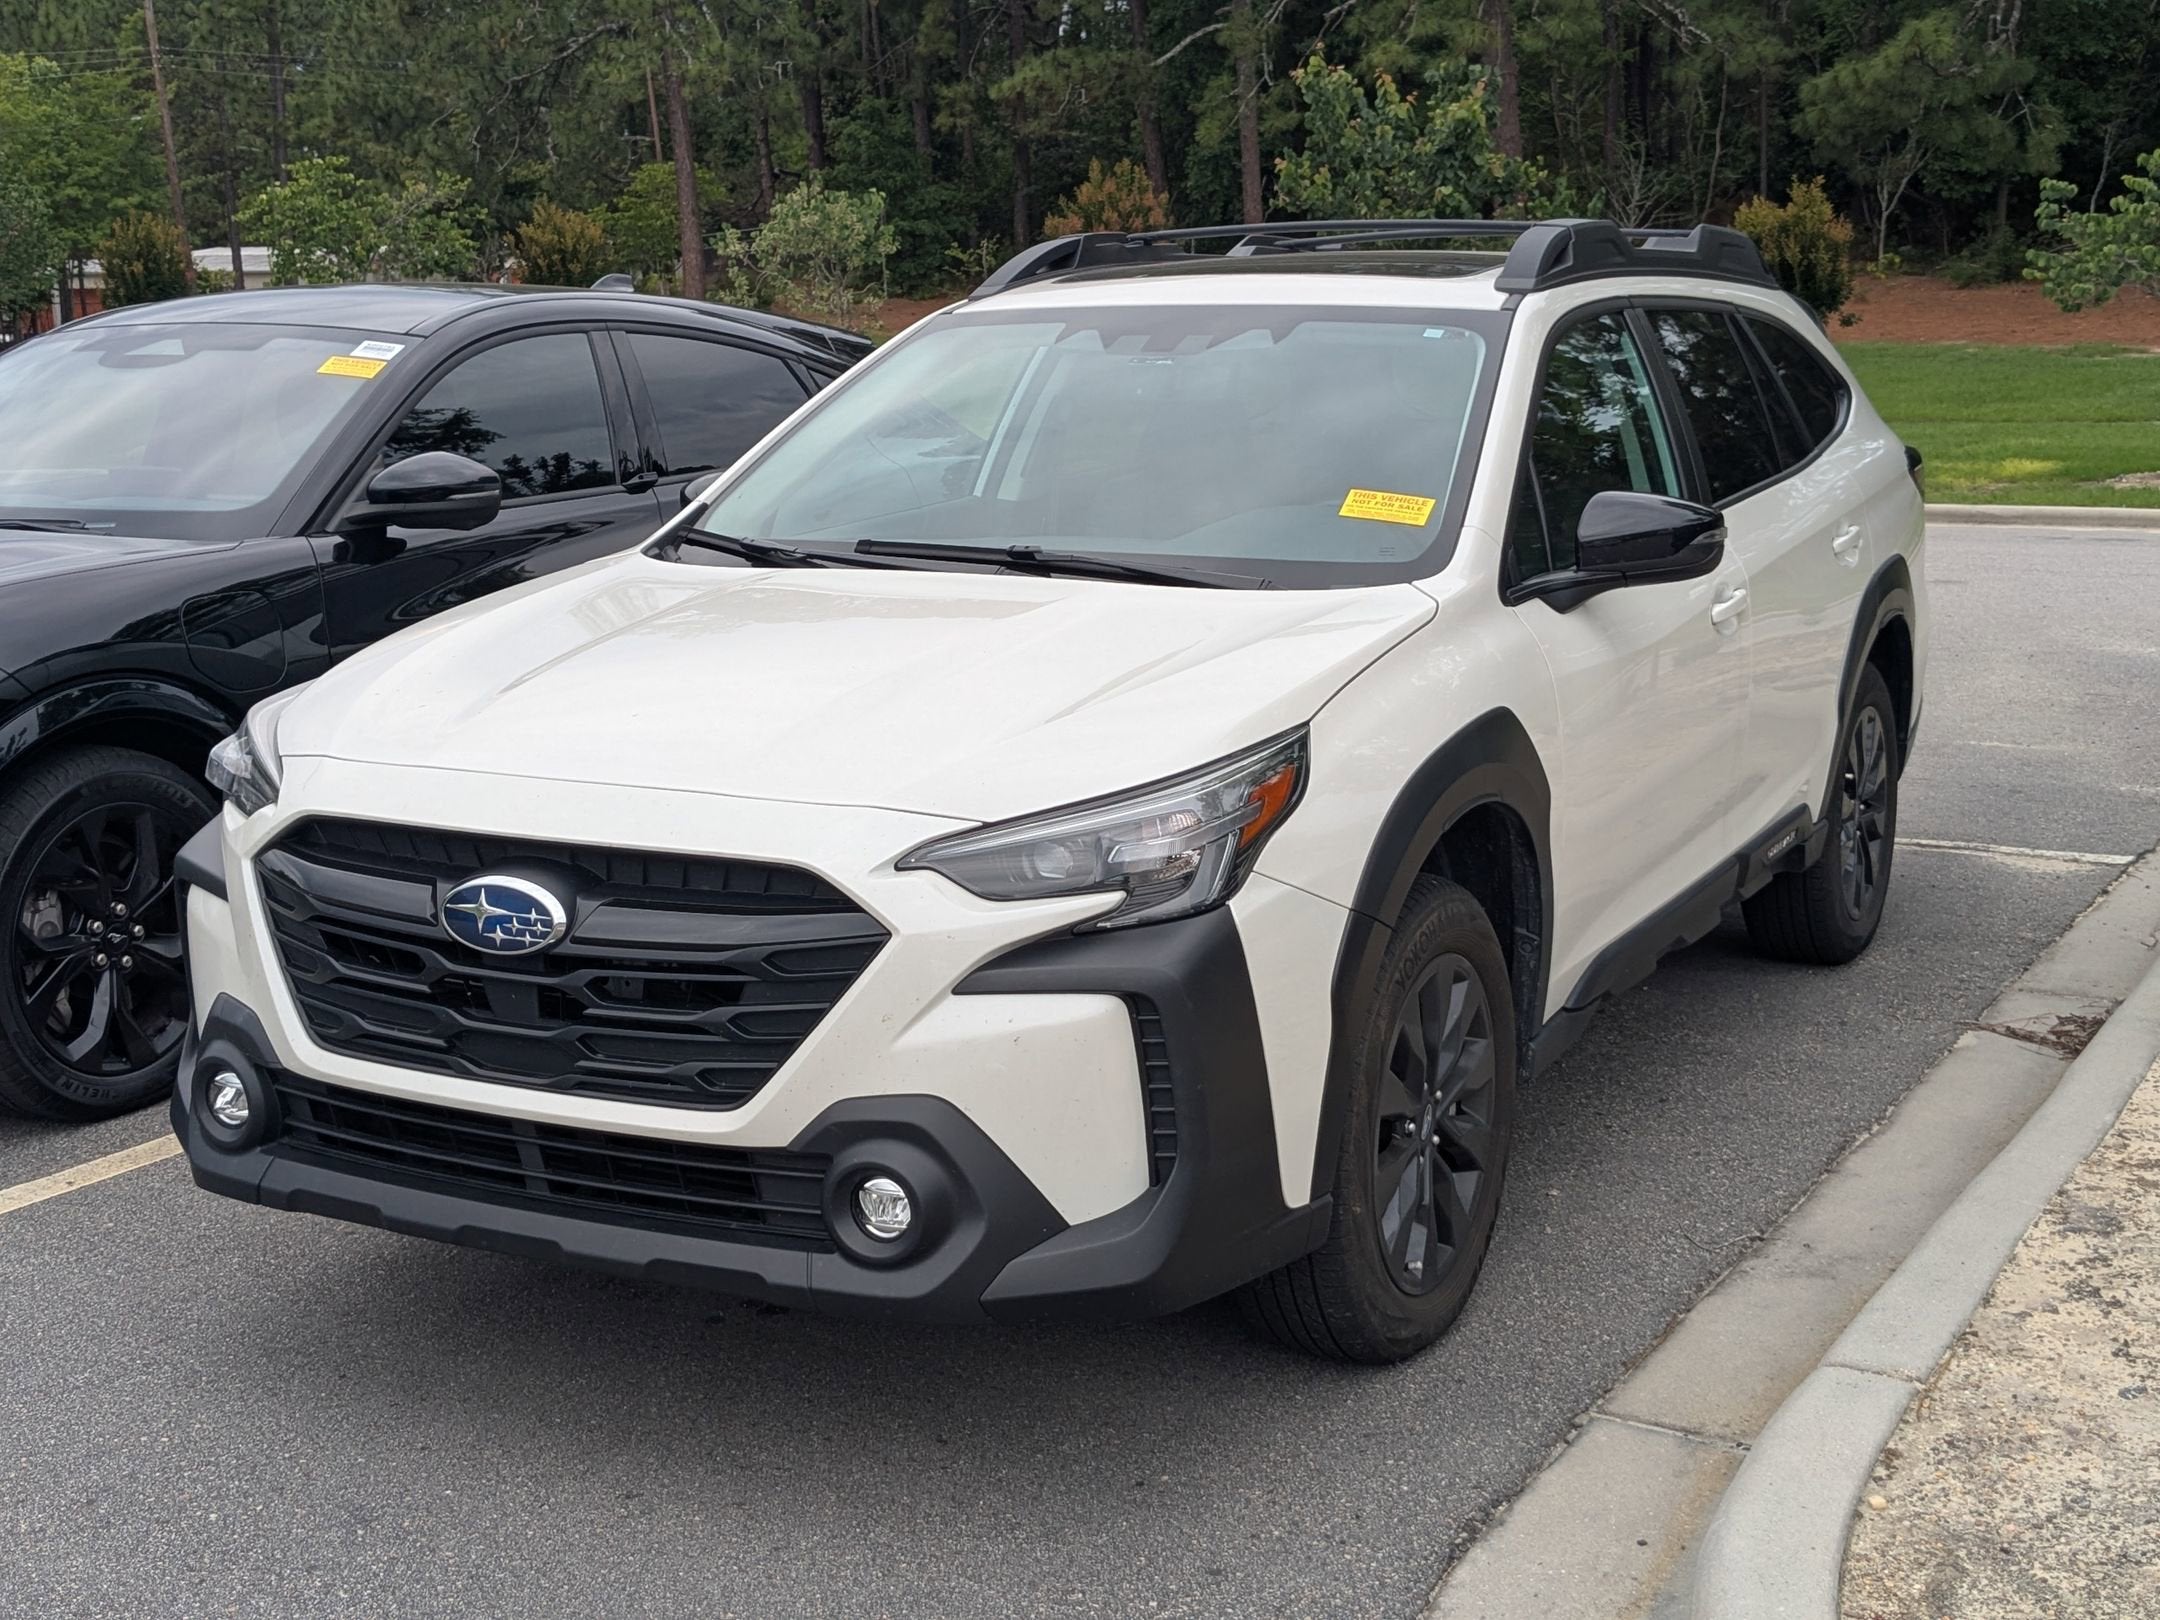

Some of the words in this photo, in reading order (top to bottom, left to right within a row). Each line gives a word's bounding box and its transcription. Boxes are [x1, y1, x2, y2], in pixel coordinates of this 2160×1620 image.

[1352, 491, 1378, 500] THIS
[1381, 494, 1429, 507] VEHICLE
[1397, 503, 1424, 512] SALE
